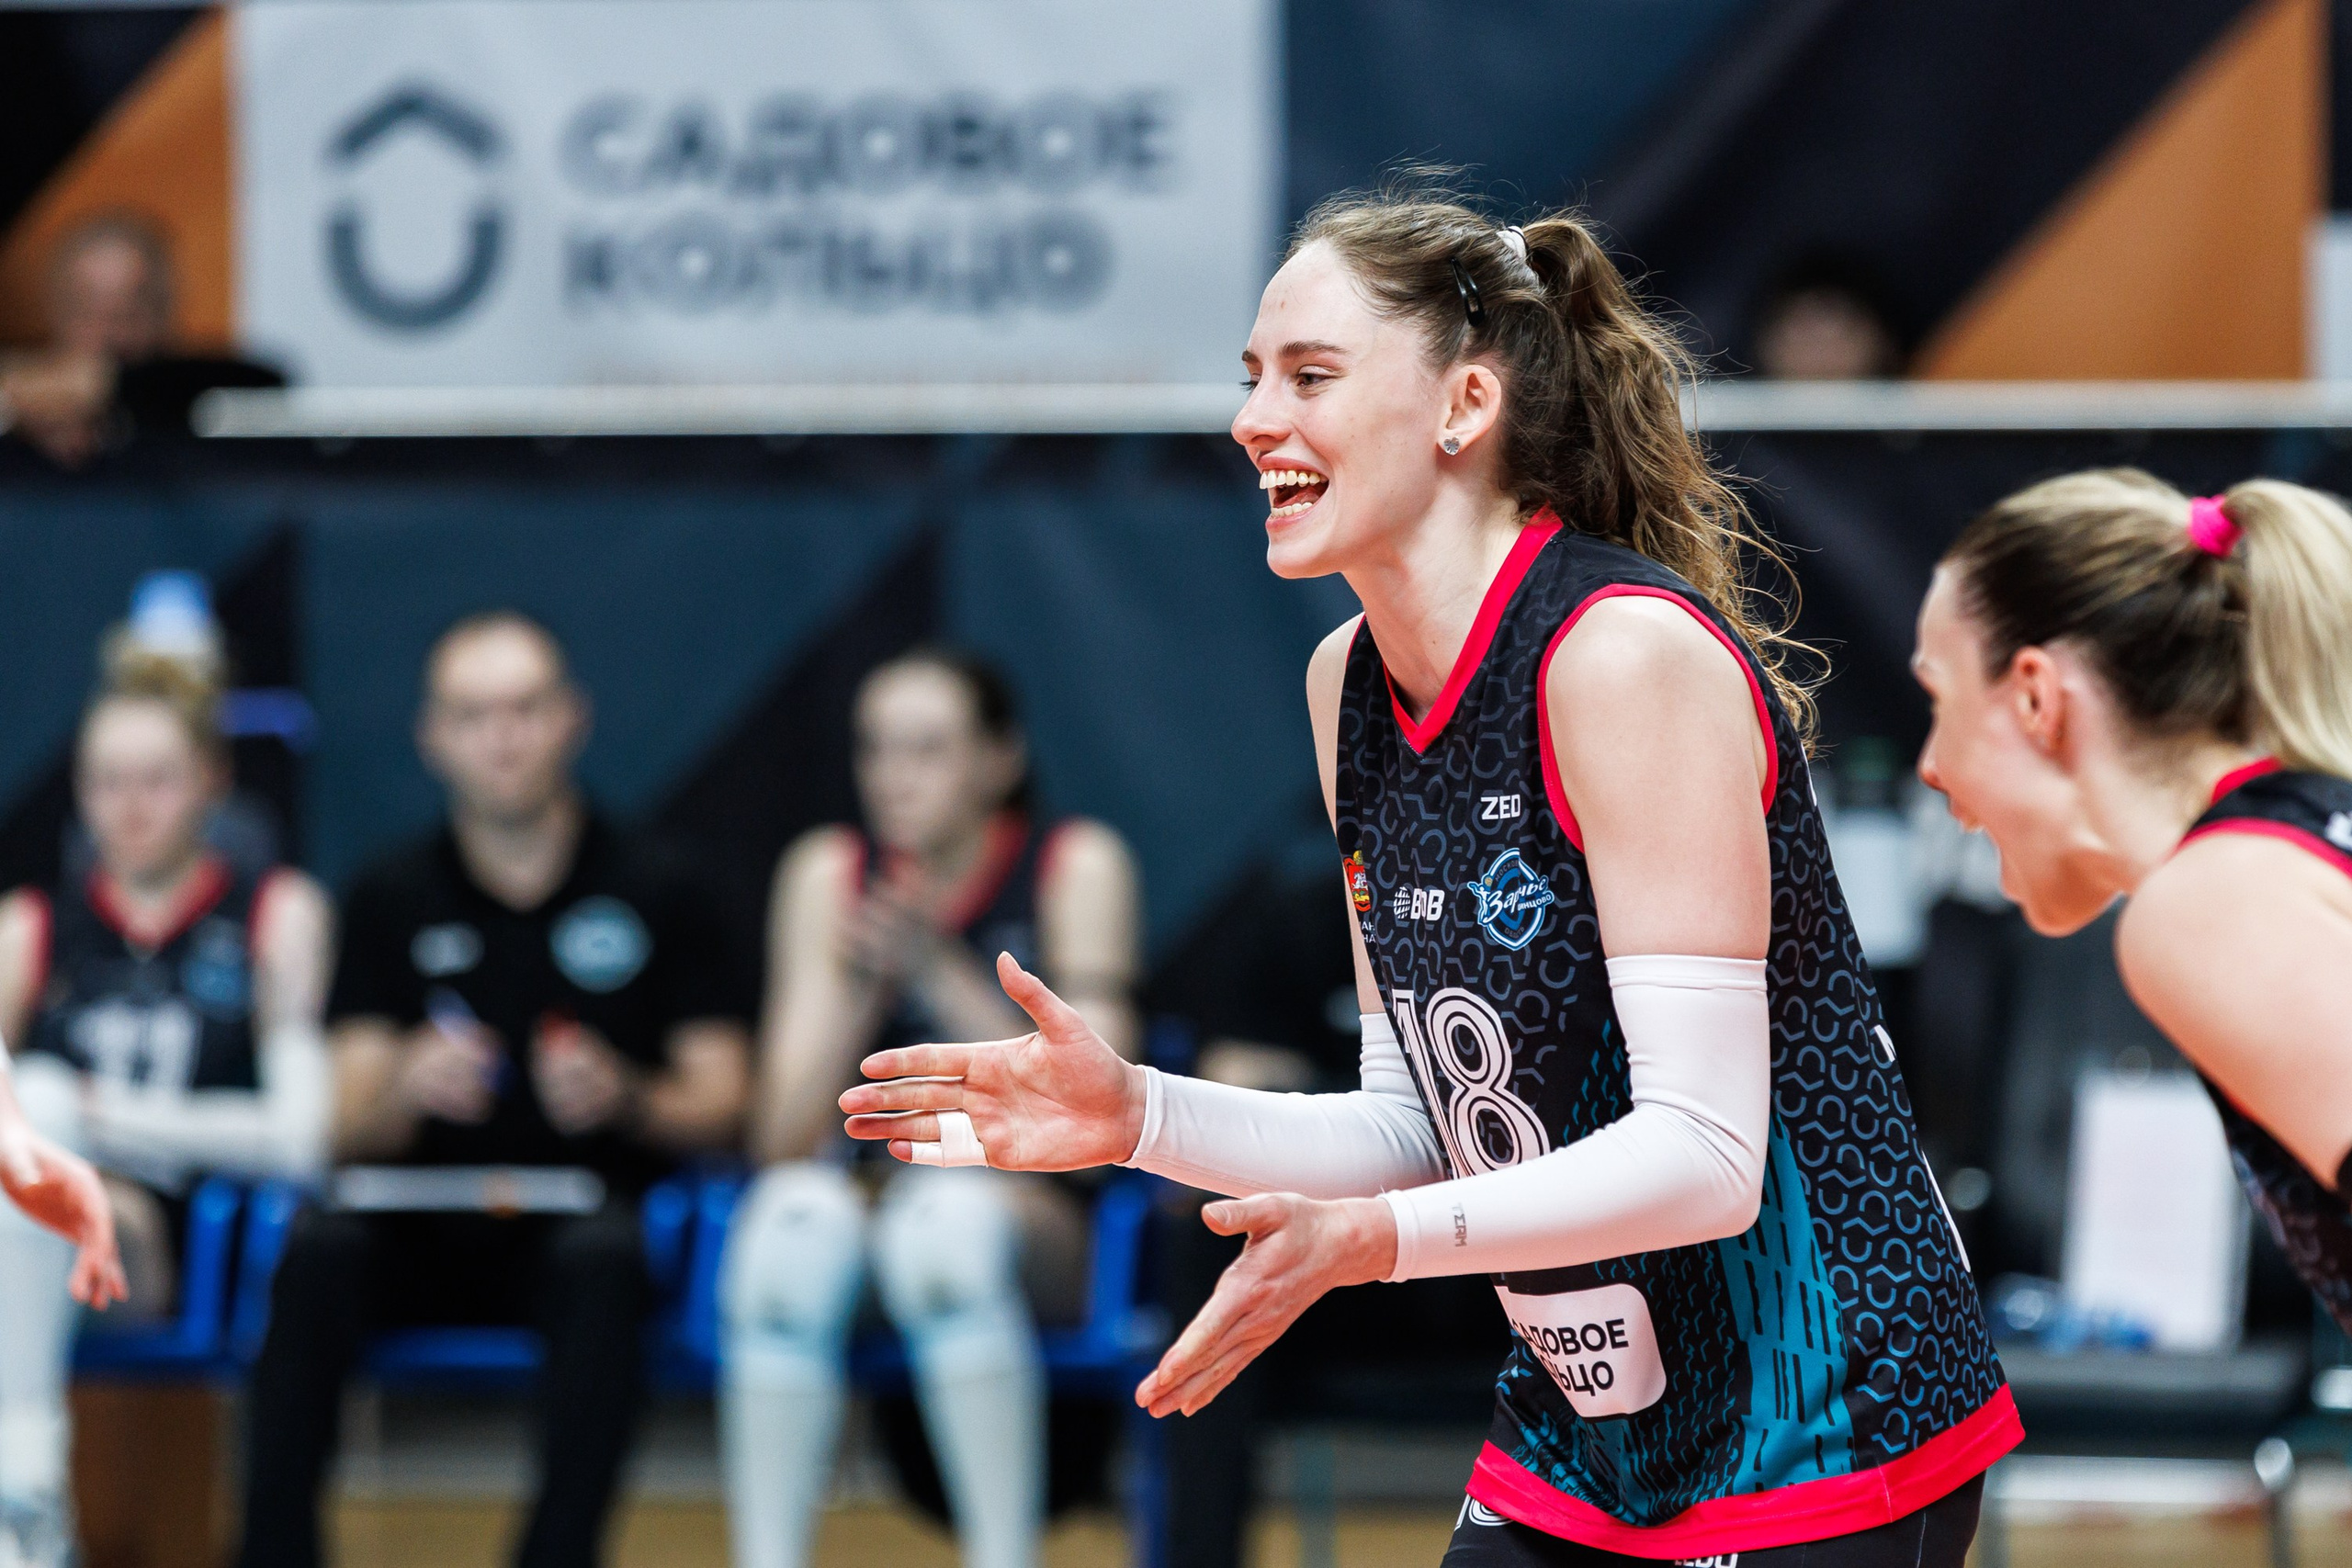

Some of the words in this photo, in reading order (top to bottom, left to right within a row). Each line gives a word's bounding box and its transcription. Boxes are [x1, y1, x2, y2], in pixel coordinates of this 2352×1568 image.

[559, 90, 1172, 195] САДОВОЕ
[562, 213, 1114, 318] КОЛЬЦО
[1480, 794, 1521, 820] ZED
[1392, 987, 1551, 1180] 18
